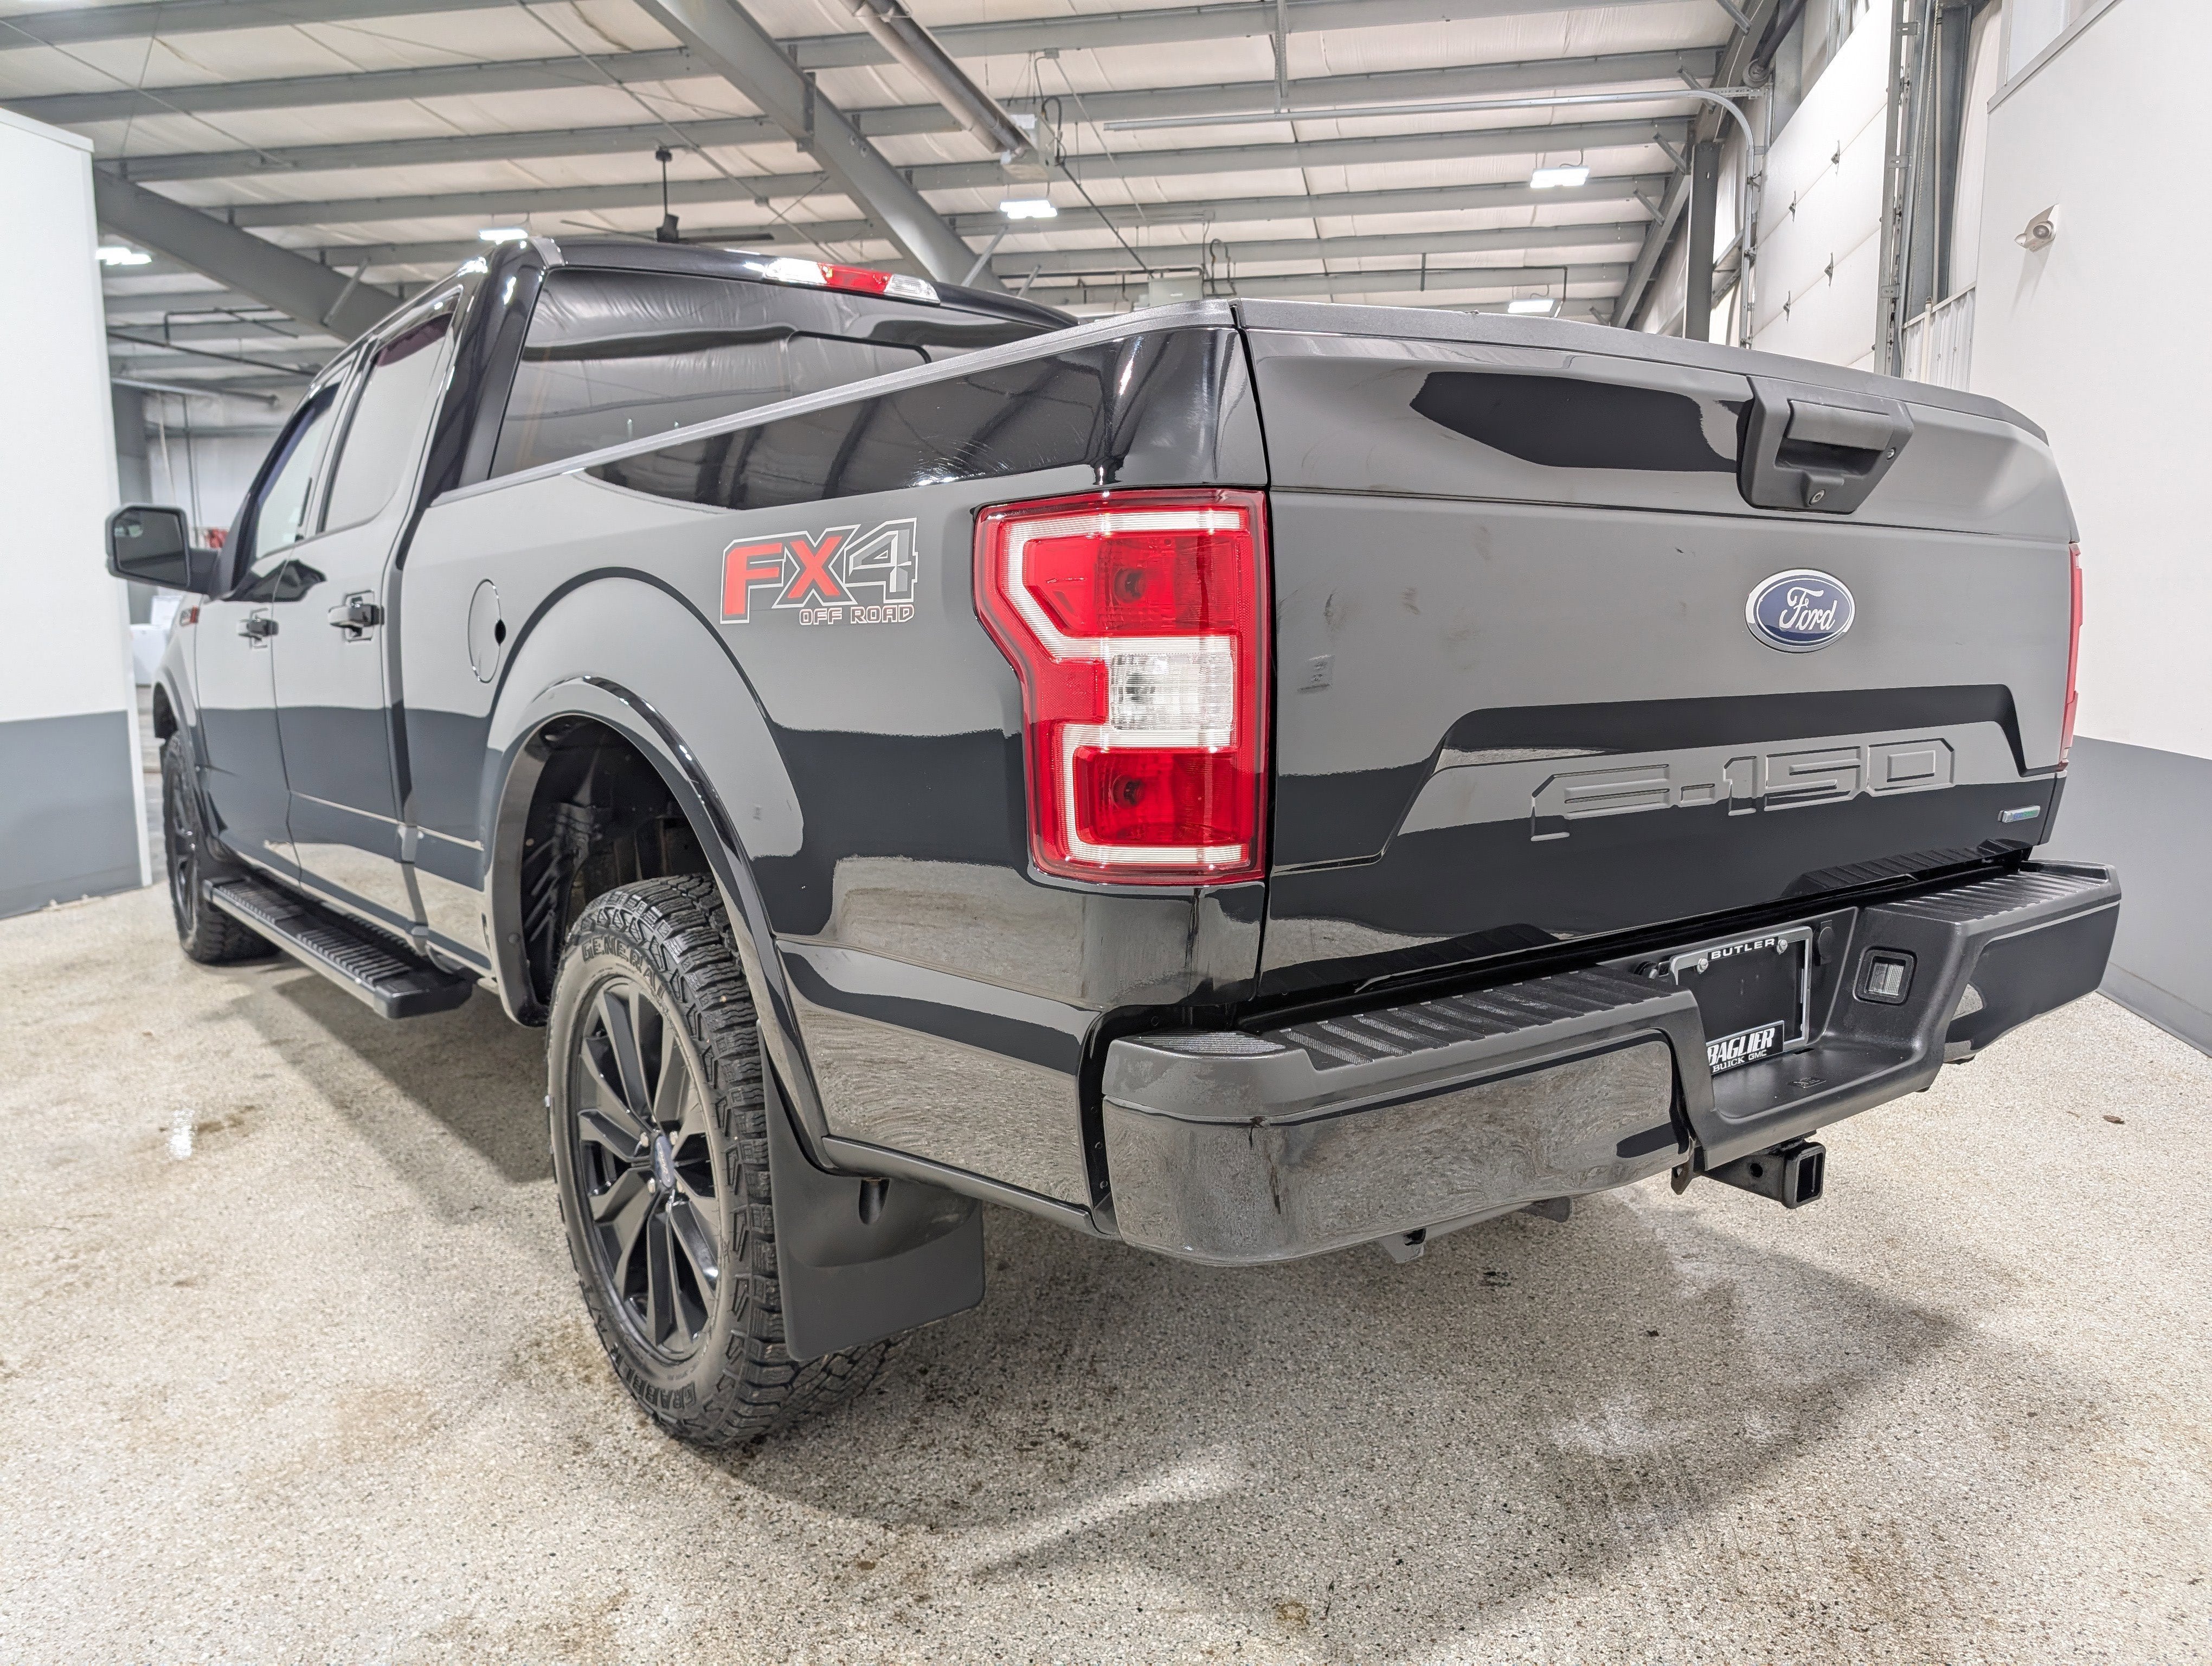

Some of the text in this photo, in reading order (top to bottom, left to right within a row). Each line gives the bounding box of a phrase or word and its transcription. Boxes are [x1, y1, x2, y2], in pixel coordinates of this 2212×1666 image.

[720, 516, 918, 624] FX4
[799, 604, 915, 625] OFF ROAD
[1779, 586, 1838, 632] Ford
[1531, 738, 1954, 841] F-150
[1711, 938, 1775, 960] BUTLER
[1707, 1027, 1776, 1066] BAGLIER
[1712, 1049, 1767, 1073] BUICK GMC
